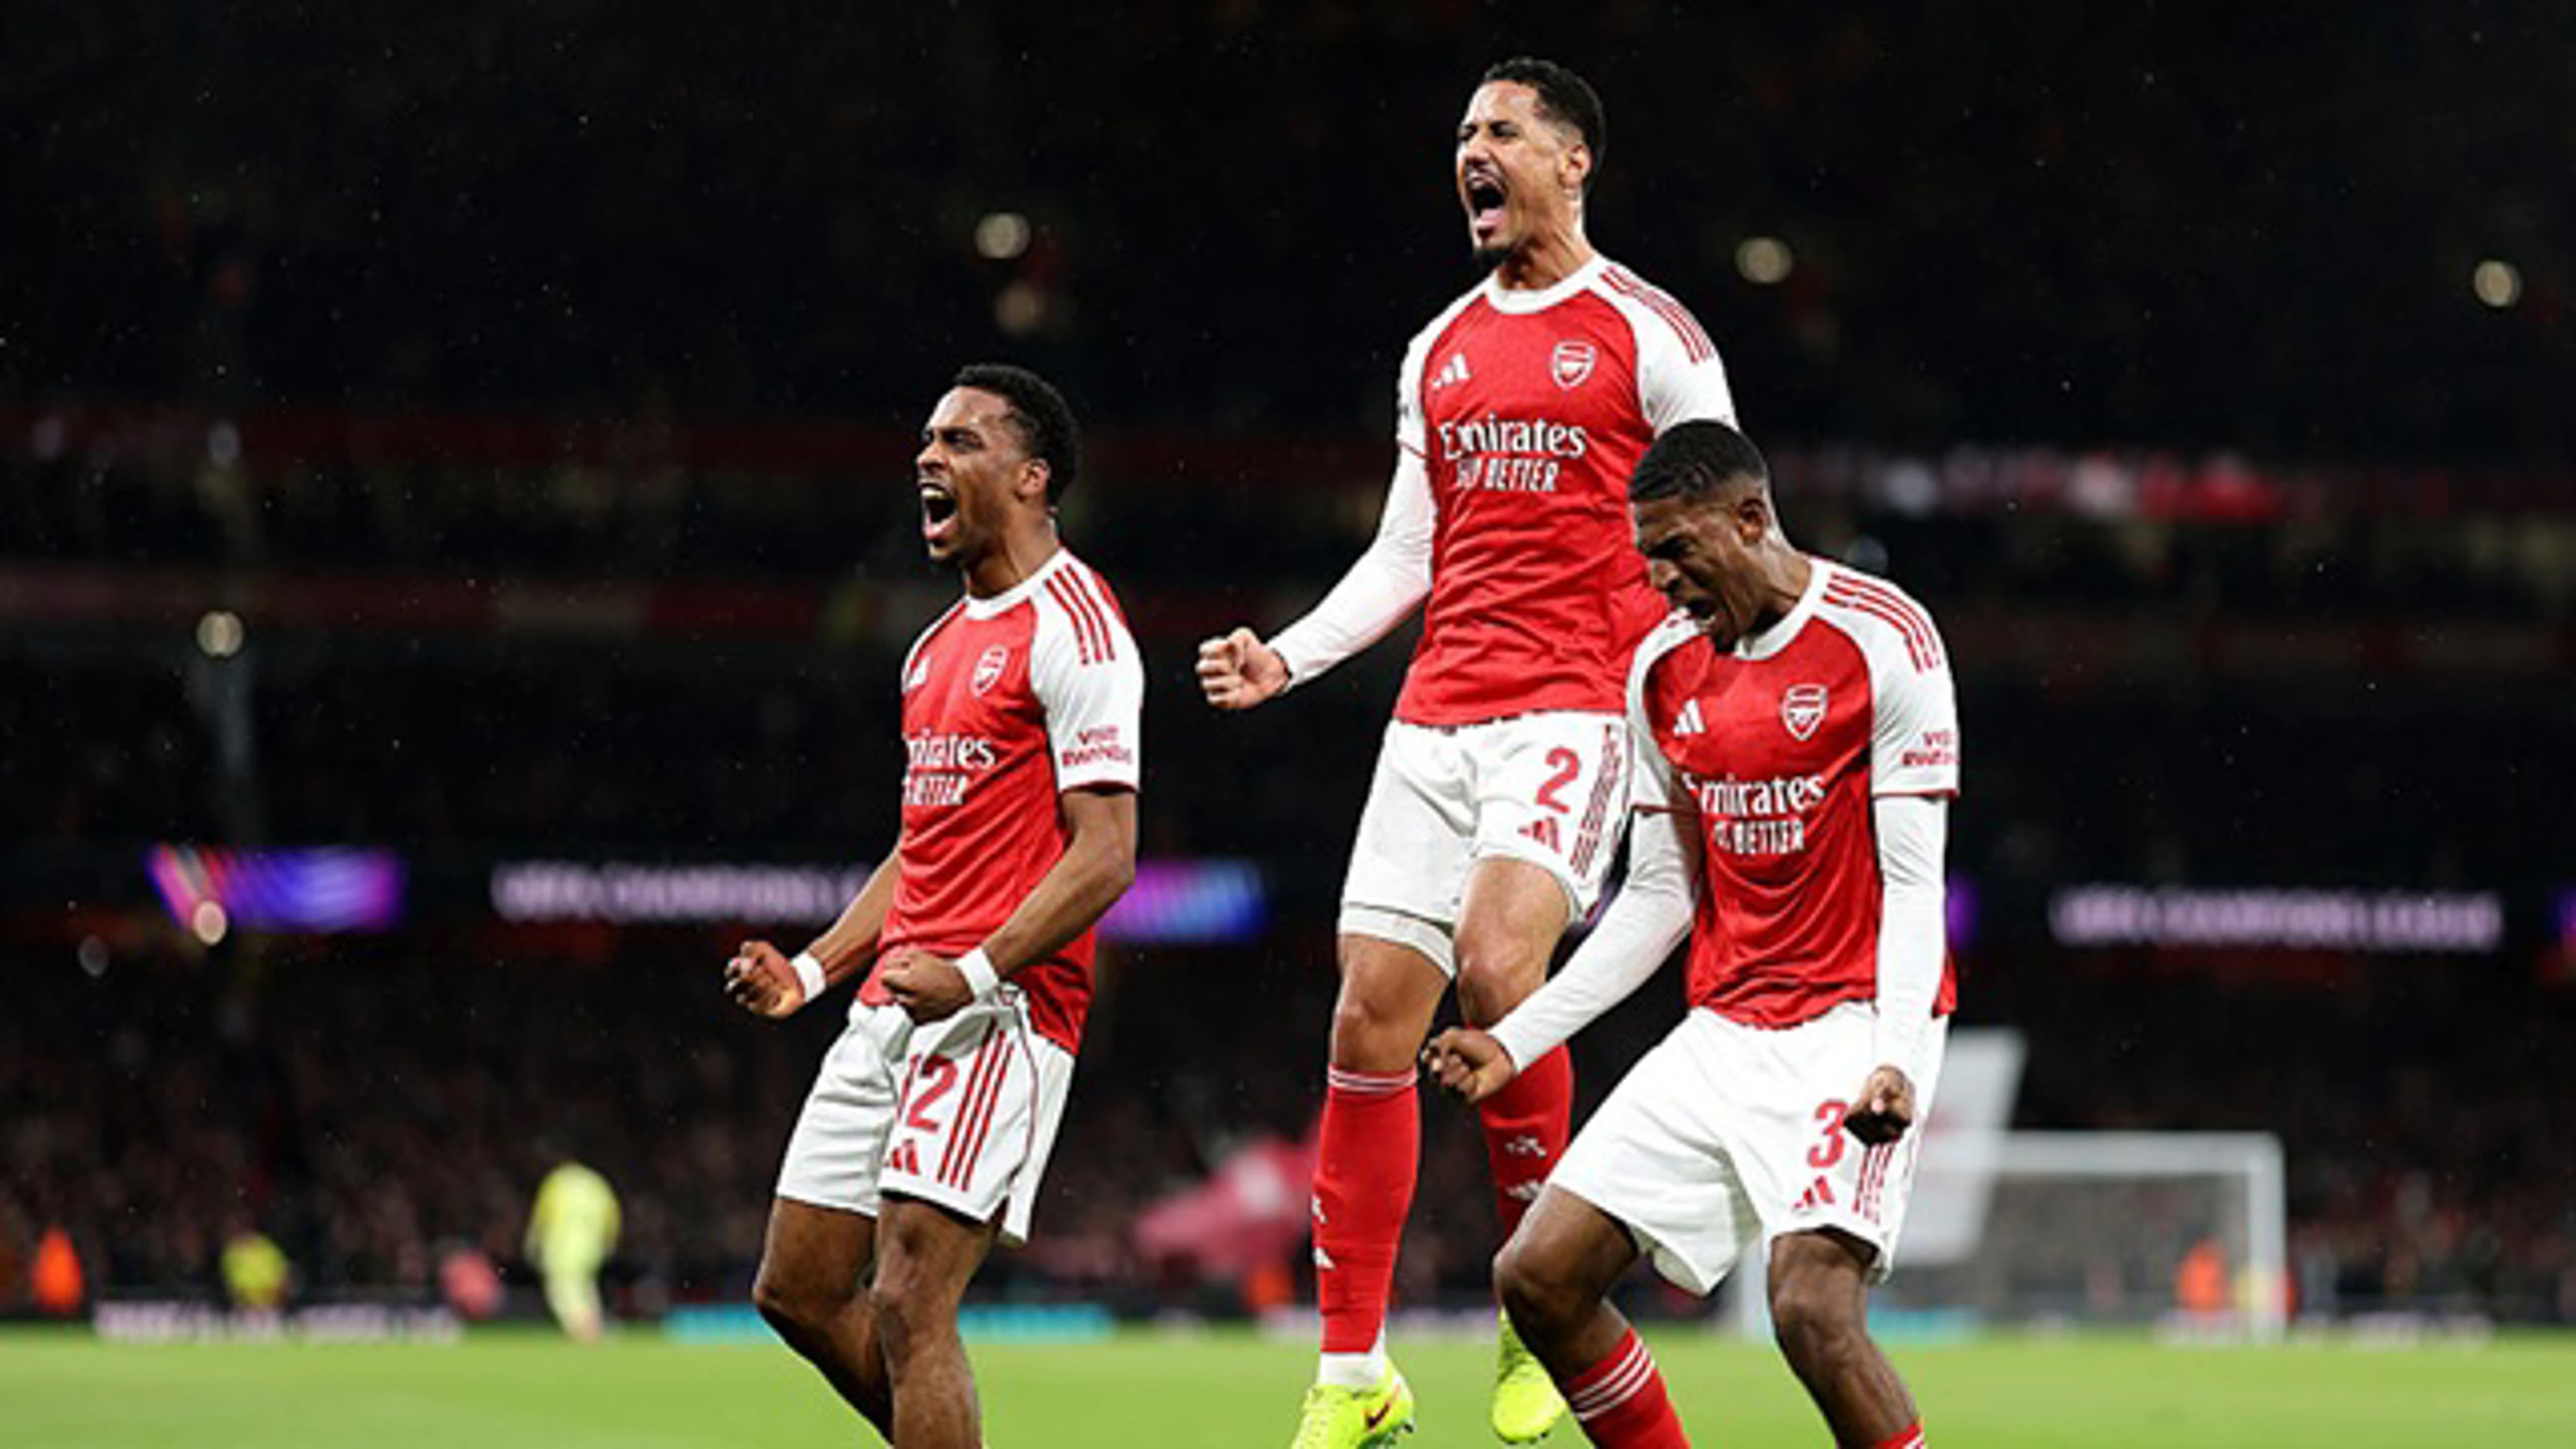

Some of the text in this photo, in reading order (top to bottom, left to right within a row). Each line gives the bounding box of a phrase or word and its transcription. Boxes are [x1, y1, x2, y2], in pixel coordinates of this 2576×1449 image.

[1440, 411, 1587, 460] Emirates
[1485, 458, 1560, 491] BETTER
[1536, 747, 1579, 814] 2
[894, 1053, 958, 1134] 12
[1807, 1097, 1848, 1169] 3
